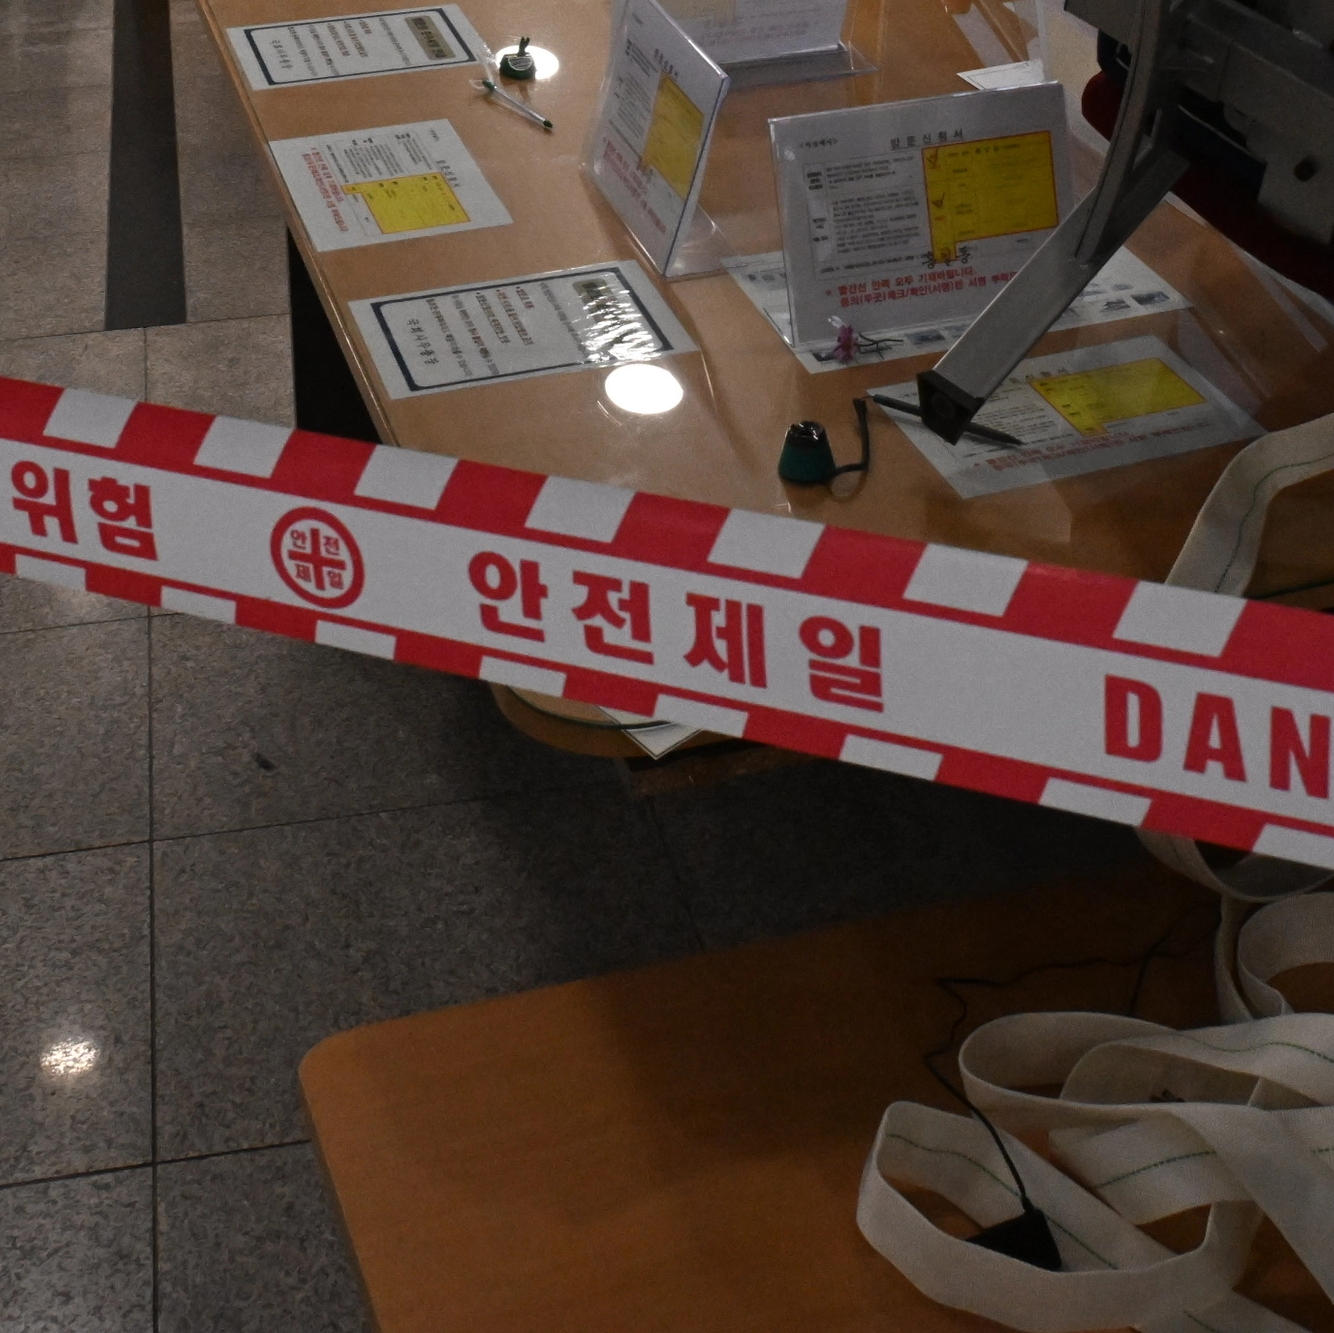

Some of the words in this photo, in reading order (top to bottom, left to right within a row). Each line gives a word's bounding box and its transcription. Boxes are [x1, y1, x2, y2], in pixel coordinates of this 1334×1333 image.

[890, 128, 963, 149] 방문신청서
[838, 280, 867, 296] 빨간선
[871, 279, 891, 291] 안쪽
[895, 275, 914, 287] 모두
[11, 459, 159, 561] 위험
[468, 548, 885, 713] 안전제일
